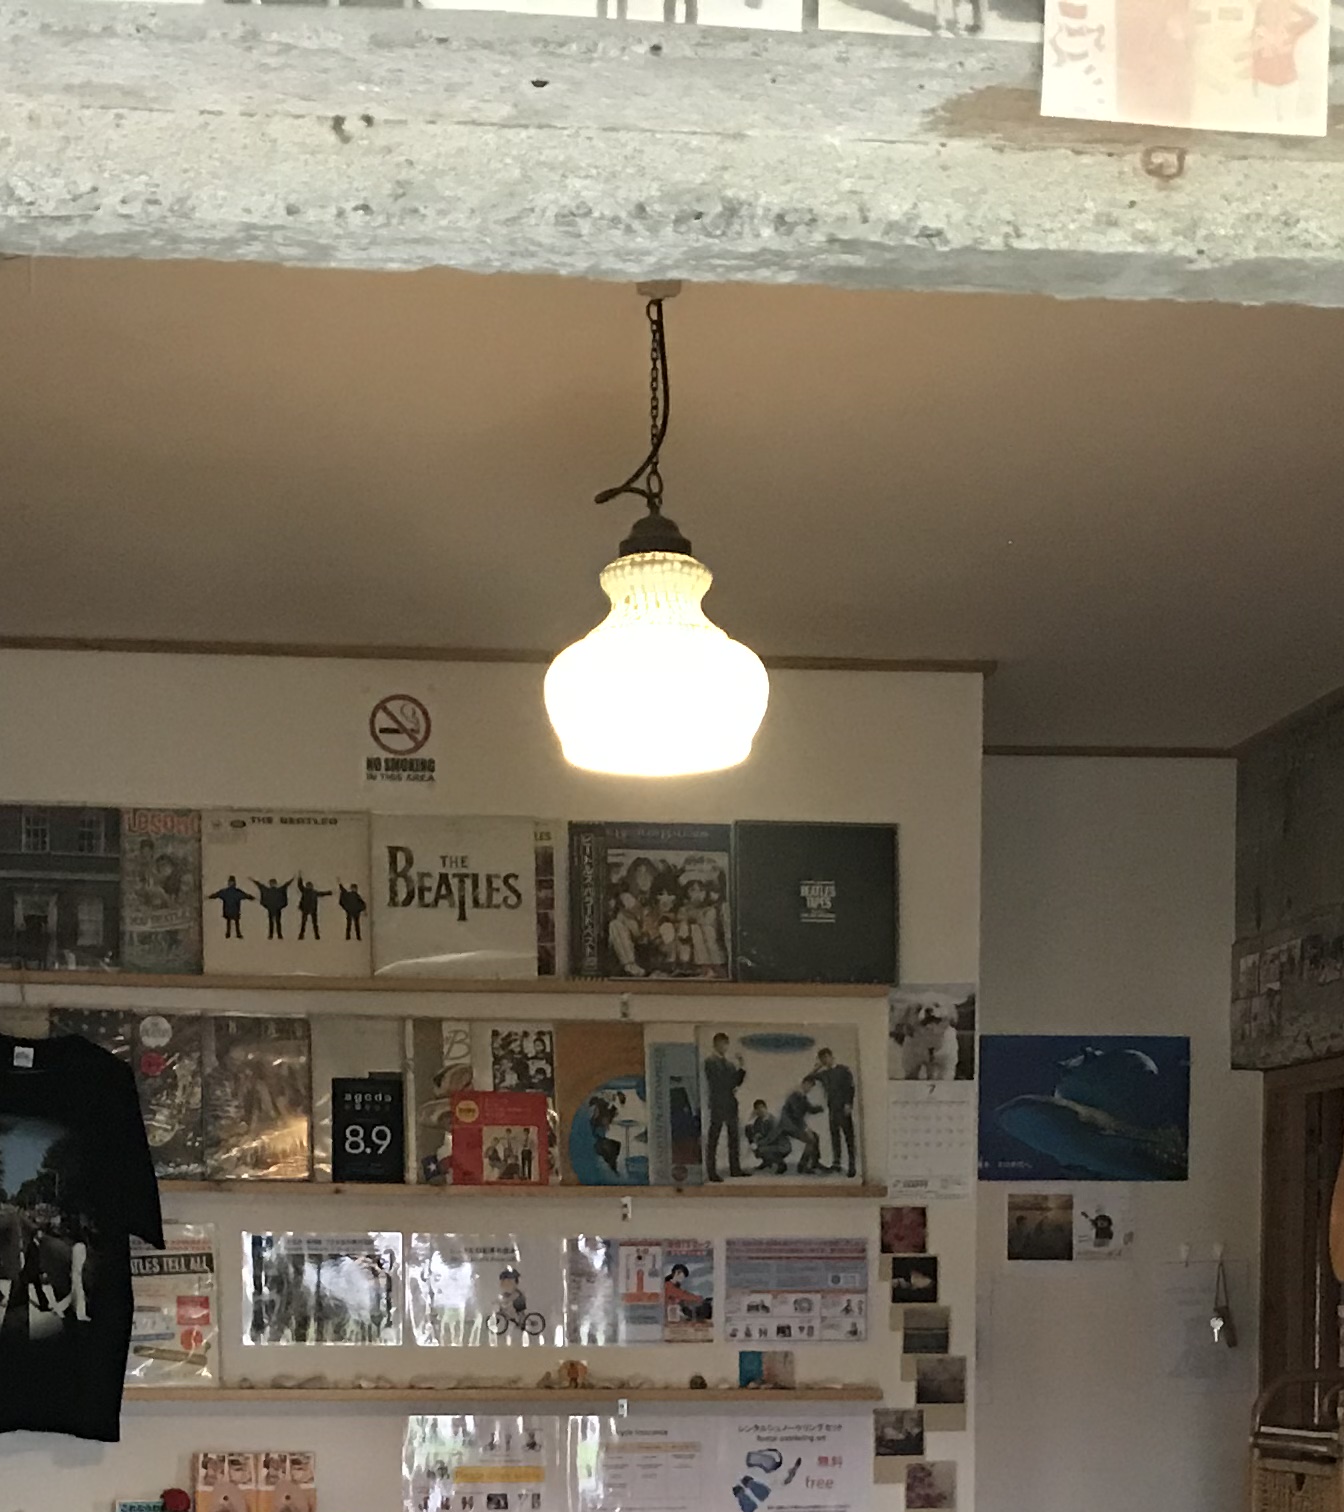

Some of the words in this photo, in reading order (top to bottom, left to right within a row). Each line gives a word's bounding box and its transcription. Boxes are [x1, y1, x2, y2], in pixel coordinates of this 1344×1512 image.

[367, 757, 381, 771] NO
[384, 757, 435, 772] SMOKING
[440, 854, 468, 869] THE
[387, 845, 522, 921] BEATLES
[344, 1092, 392, 1104] agoda
[345, 1125, 392, 1155] 8.9
[805, 1476, 835, 1489] free
